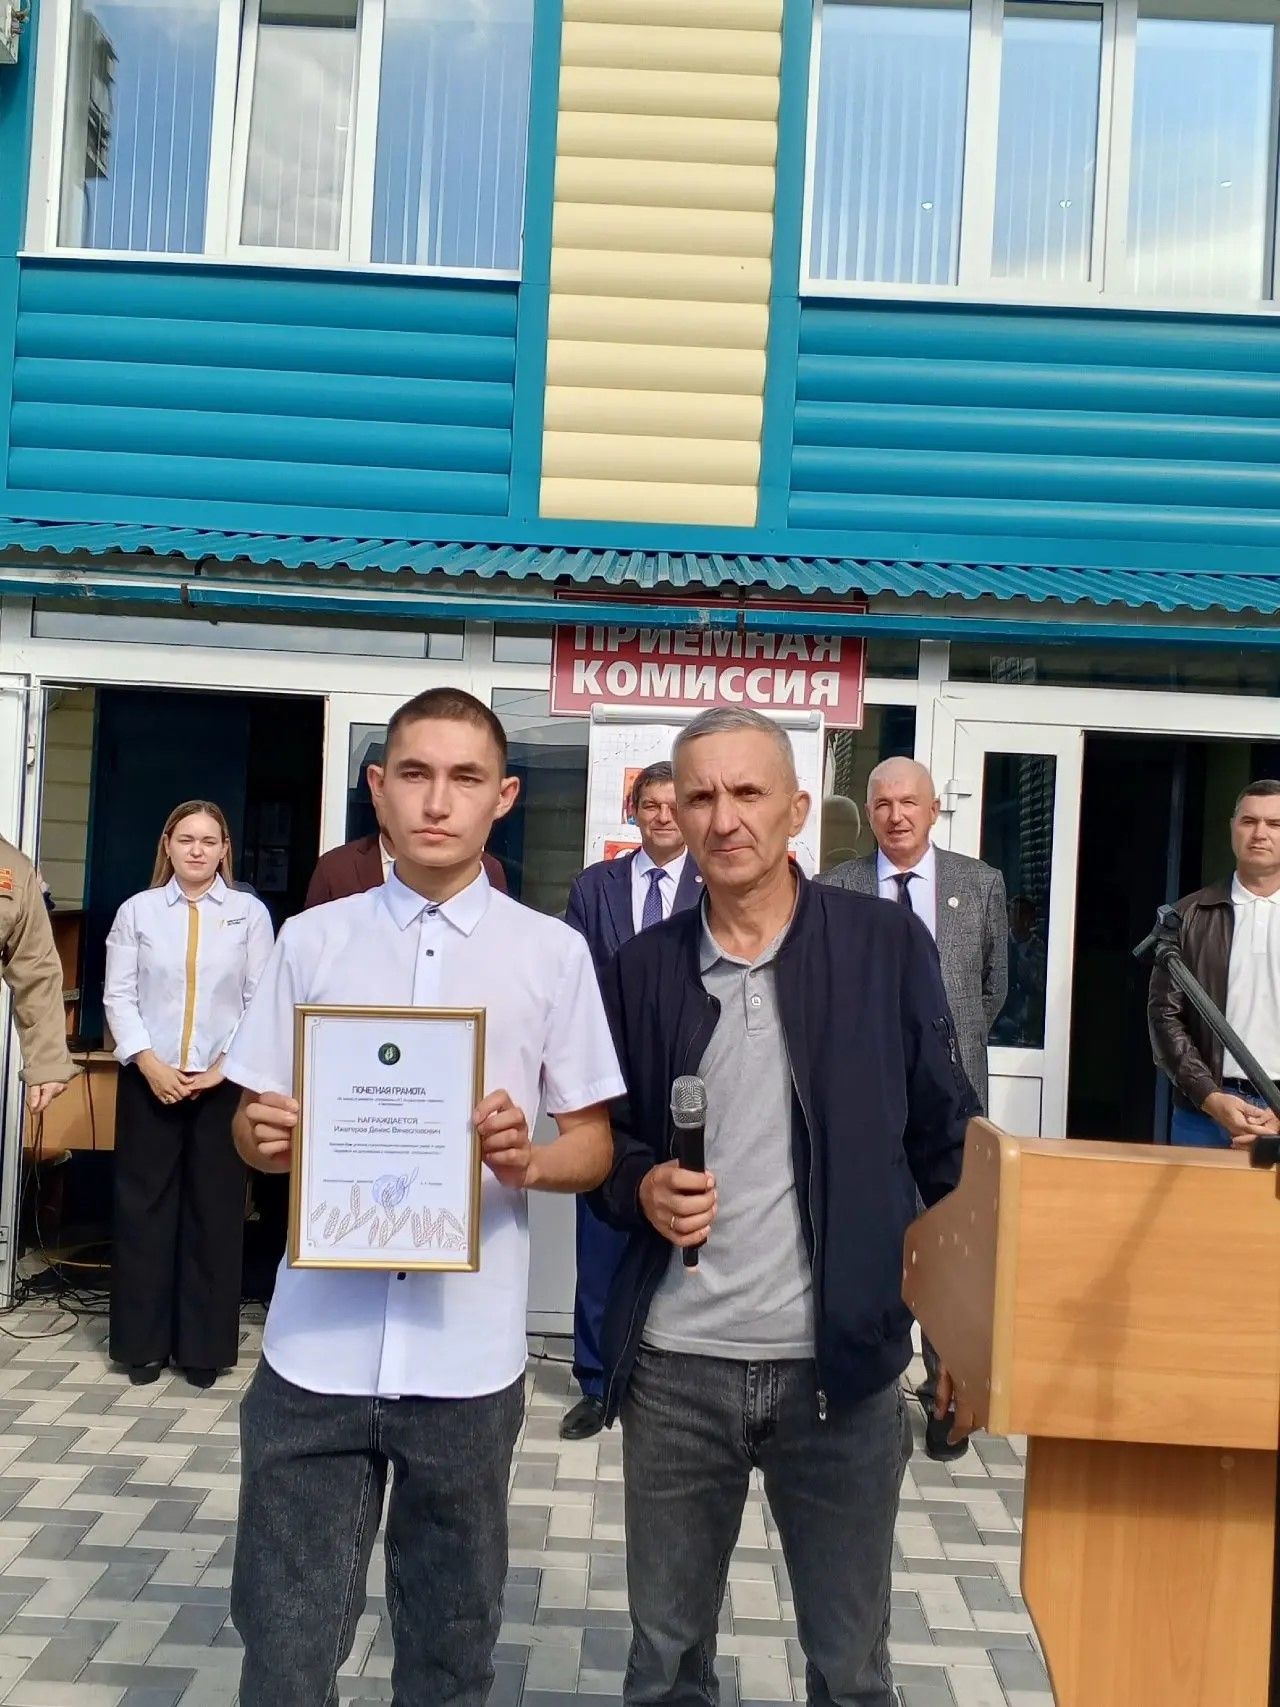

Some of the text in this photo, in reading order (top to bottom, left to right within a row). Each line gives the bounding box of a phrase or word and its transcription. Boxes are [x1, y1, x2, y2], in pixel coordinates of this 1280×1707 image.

[573, 625, 842, 662] ПРИЕМНАЯ
[572, 659, 841, 707] КОМИССИЯ
[392, 1087, 426, 1096] ГРАМОТА
[357, 1116, 418, 1125] НАГРАЖДАЕТСЯ
